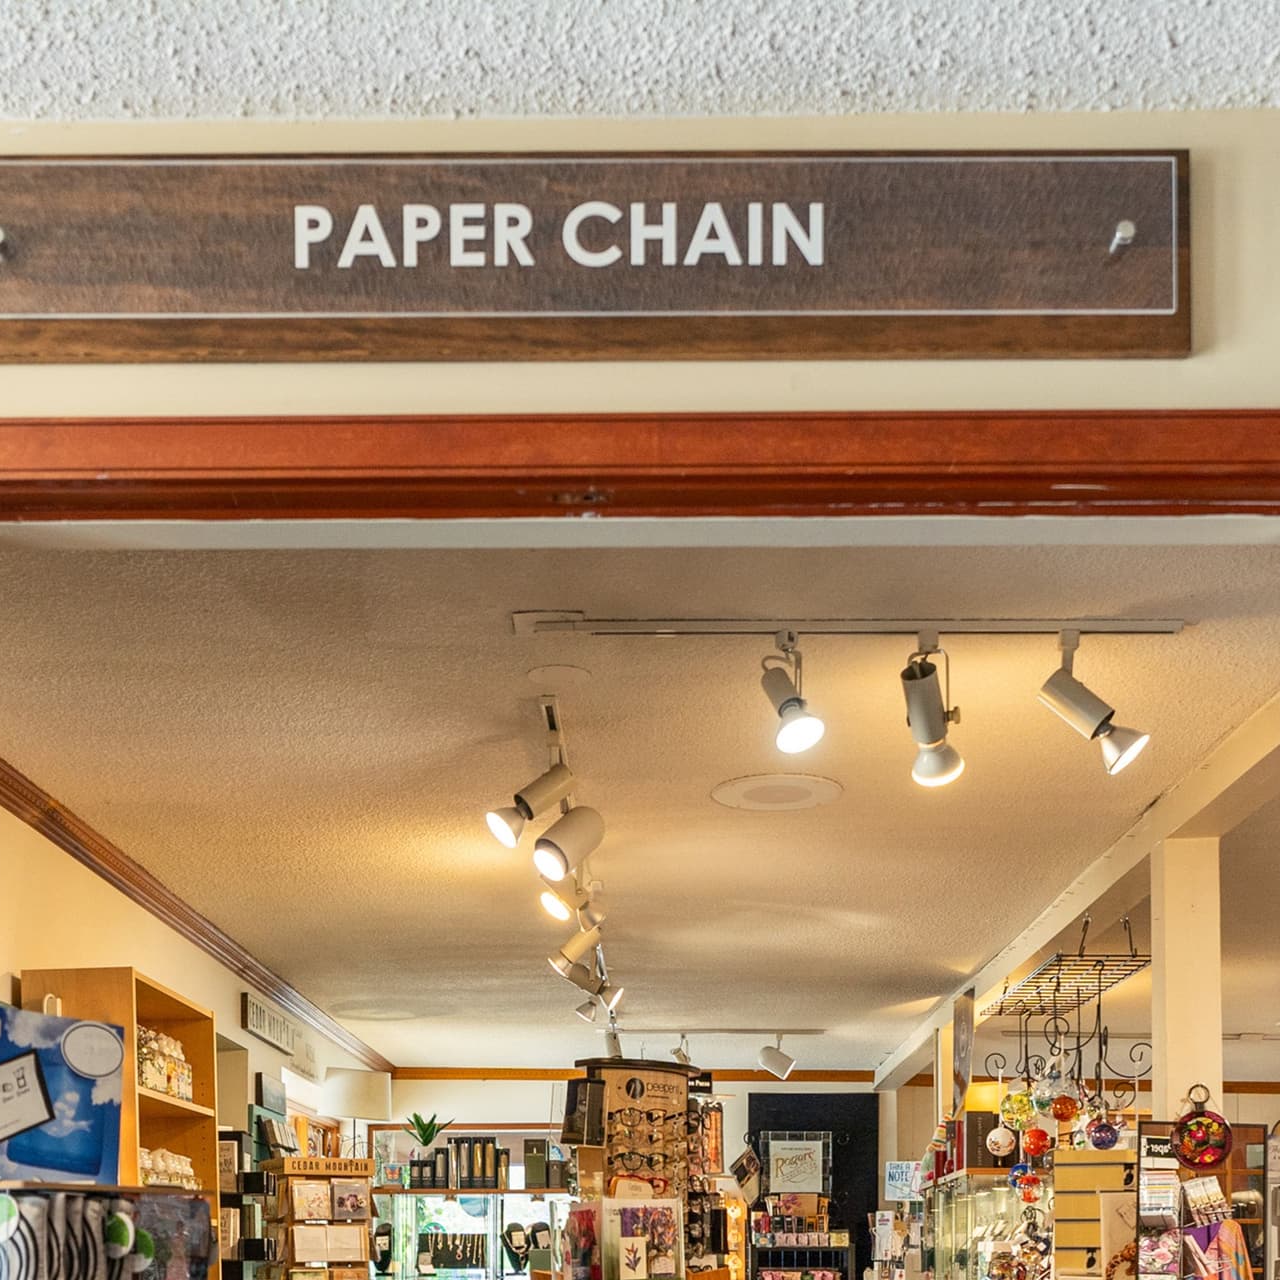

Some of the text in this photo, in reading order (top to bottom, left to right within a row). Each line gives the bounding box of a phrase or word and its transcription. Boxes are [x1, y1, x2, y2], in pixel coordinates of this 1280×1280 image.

[294, 201, 824, 269] PAPER CHAIN
[292, 1158, 369, 1173] CEDAR MOUNTAIN
[888, 1171, 910, 1182] NOTE
